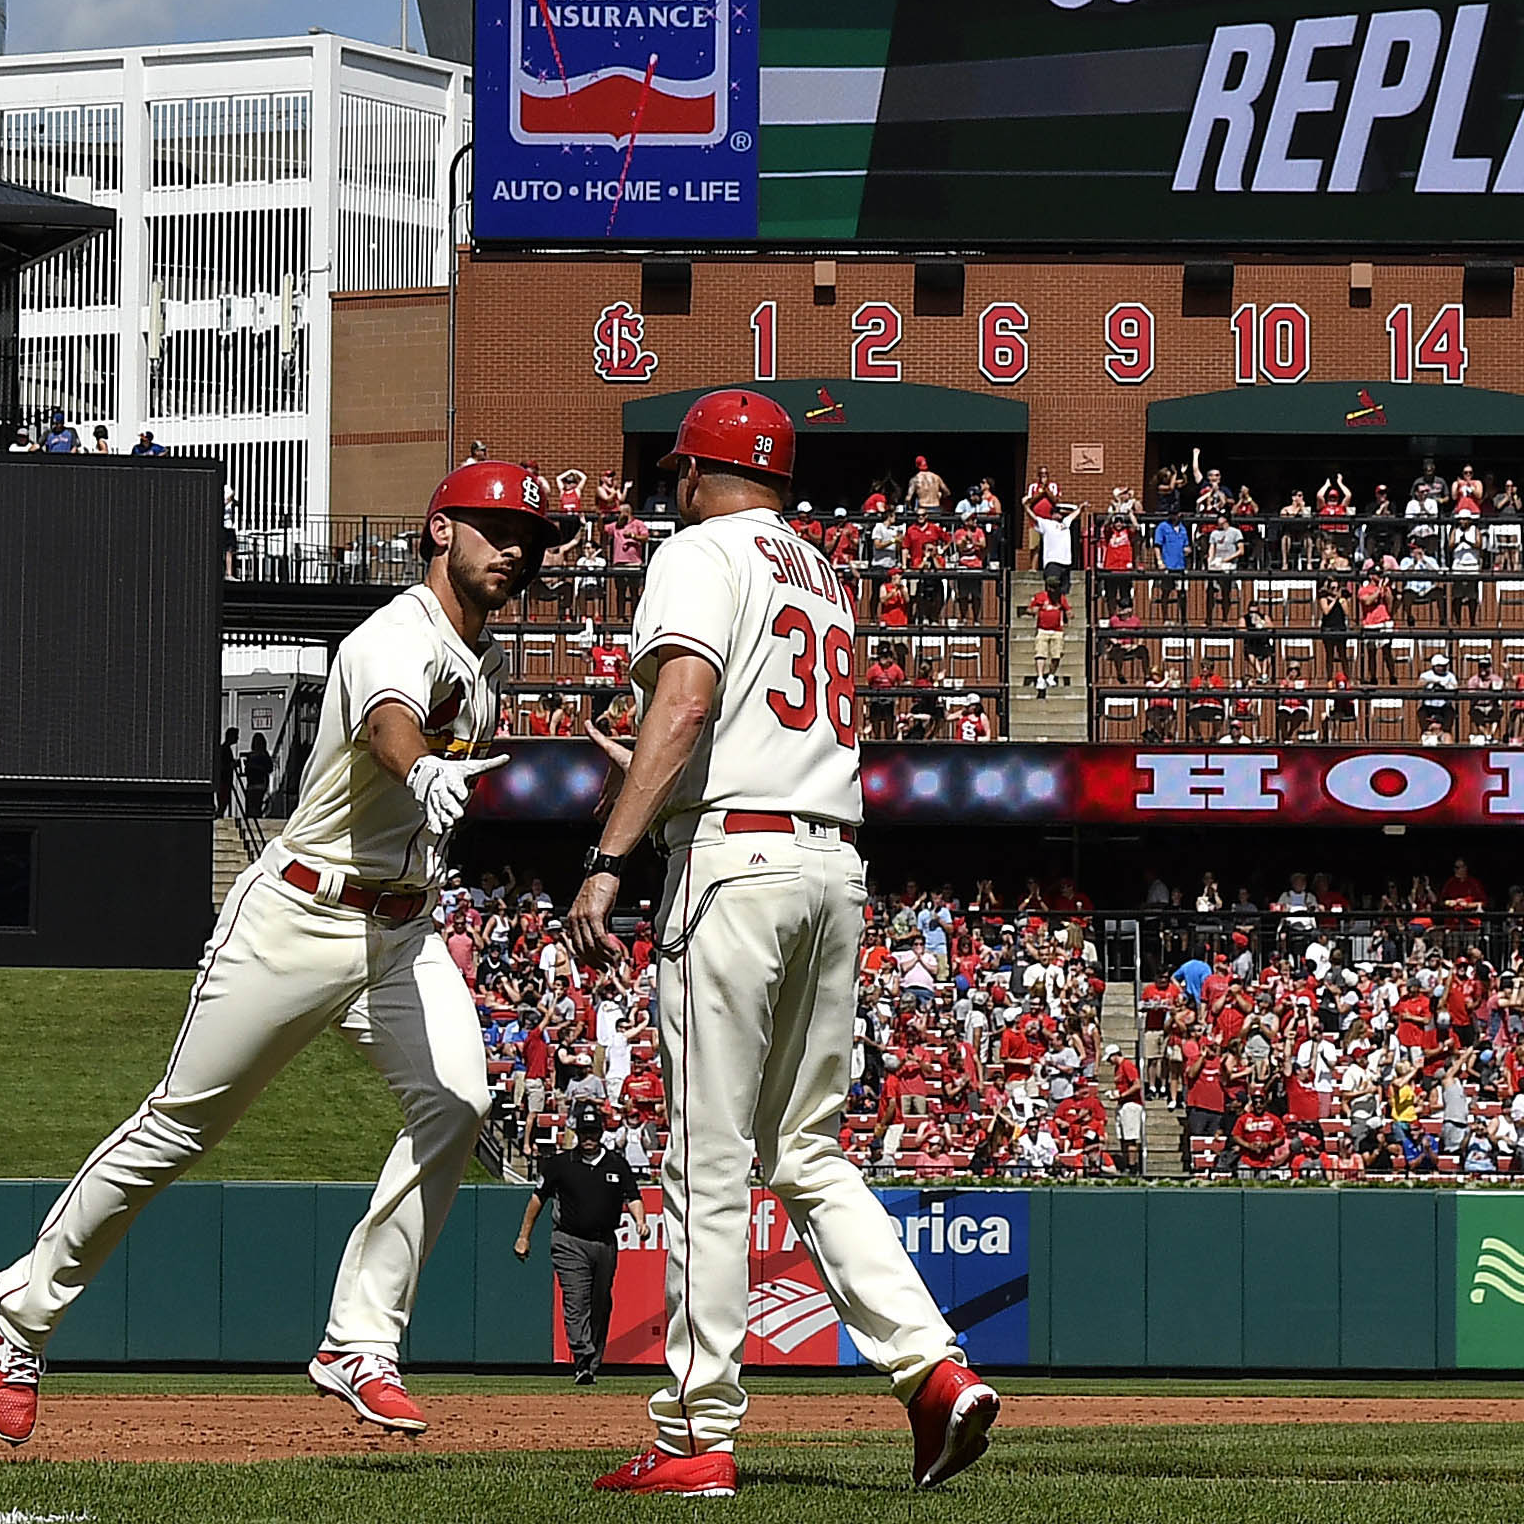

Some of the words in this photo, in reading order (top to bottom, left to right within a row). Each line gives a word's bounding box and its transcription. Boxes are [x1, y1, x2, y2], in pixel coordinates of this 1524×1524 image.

[528, 5, 709, 28] INSURANCE
[493, 181, 562, 201] AUTO
[585, 181, 662, 202] HOME
[685, 181, 741, 202] LIFE
[750, 300, 776, 381] 1
[851, 301, 902, 381] 2
[978, 301, 1029, 382] 6
[1104, 302, 1155, 383] 9
[1231, 303, 1310, 384] 10
[1386, 303, 1468, 385] 14
[754, 435, 773, 453] 38
[766, 604, 856, 750] 38
